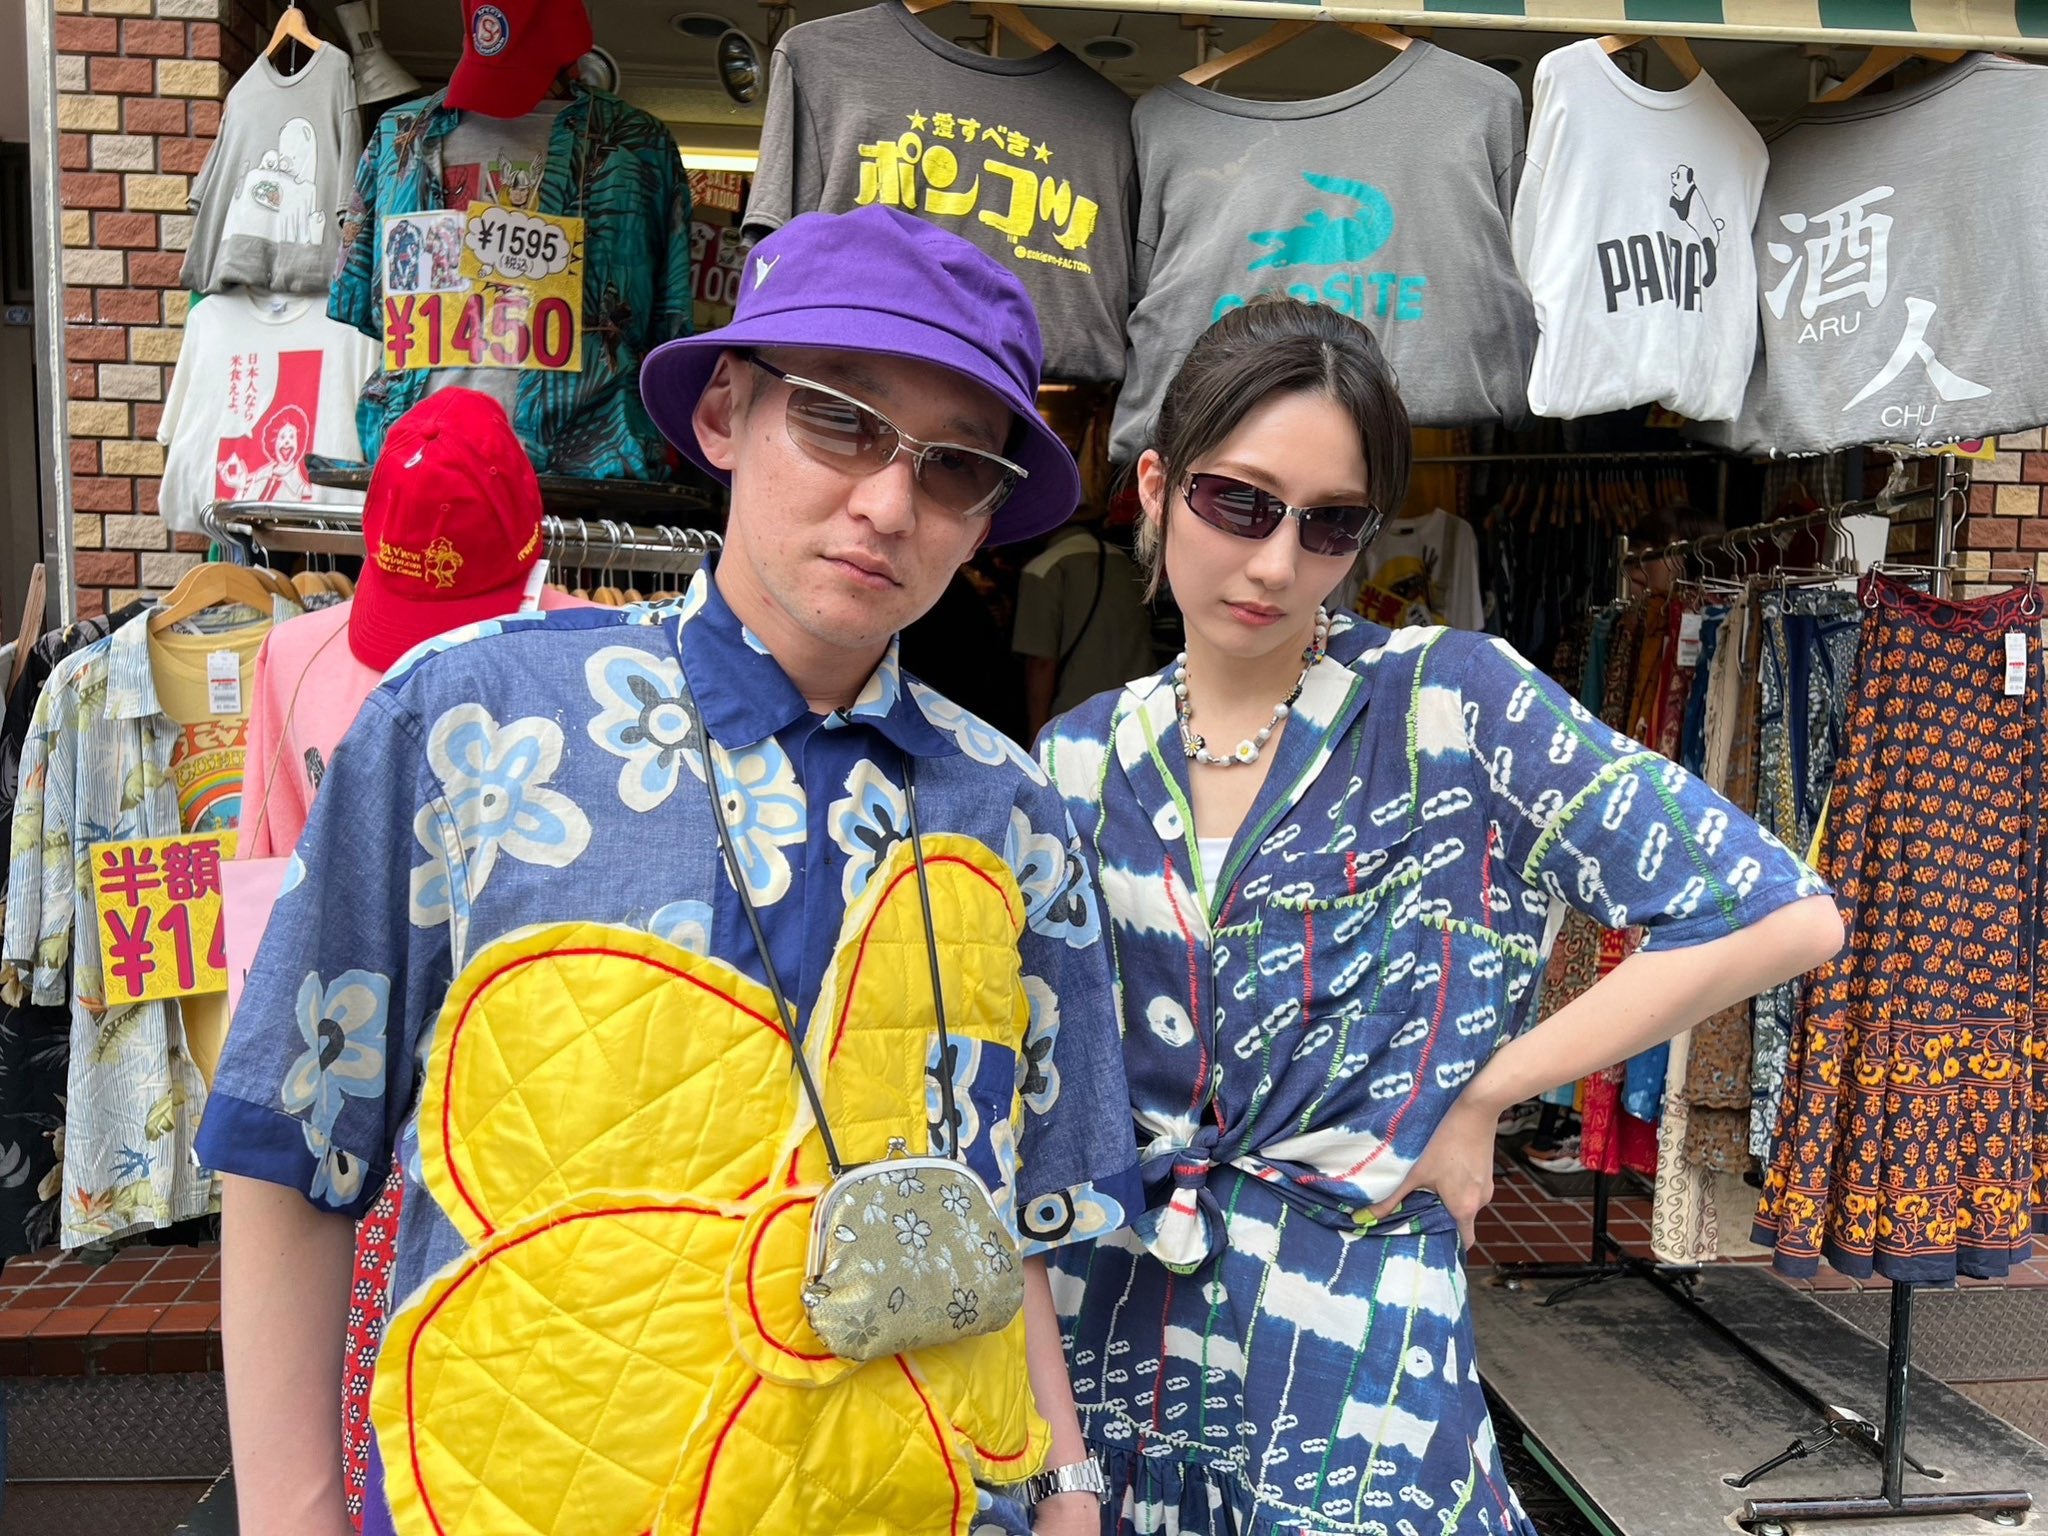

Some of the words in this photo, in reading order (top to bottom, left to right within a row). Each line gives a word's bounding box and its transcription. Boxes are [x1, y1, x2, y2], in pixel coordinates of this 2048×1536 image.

[931, 111, 1031, 158] 愛すべき
[853, 131, 1099, 250] ポンコツ
[478, 218, 560, 263] ¥1595
[500, 254, 535, 274] (税込)
[1764, 184, 1896, 320] 酒
[384, 292, 575, 369] ¥1450
[1797, 311, 1862, 345] ARU
[1841, 296, 1993, 412] 人
[244, 352, 260, 422] 日本人なら
[1880, 403, 1938, 428] CHU
[99, 839, 222, 908] 半額
